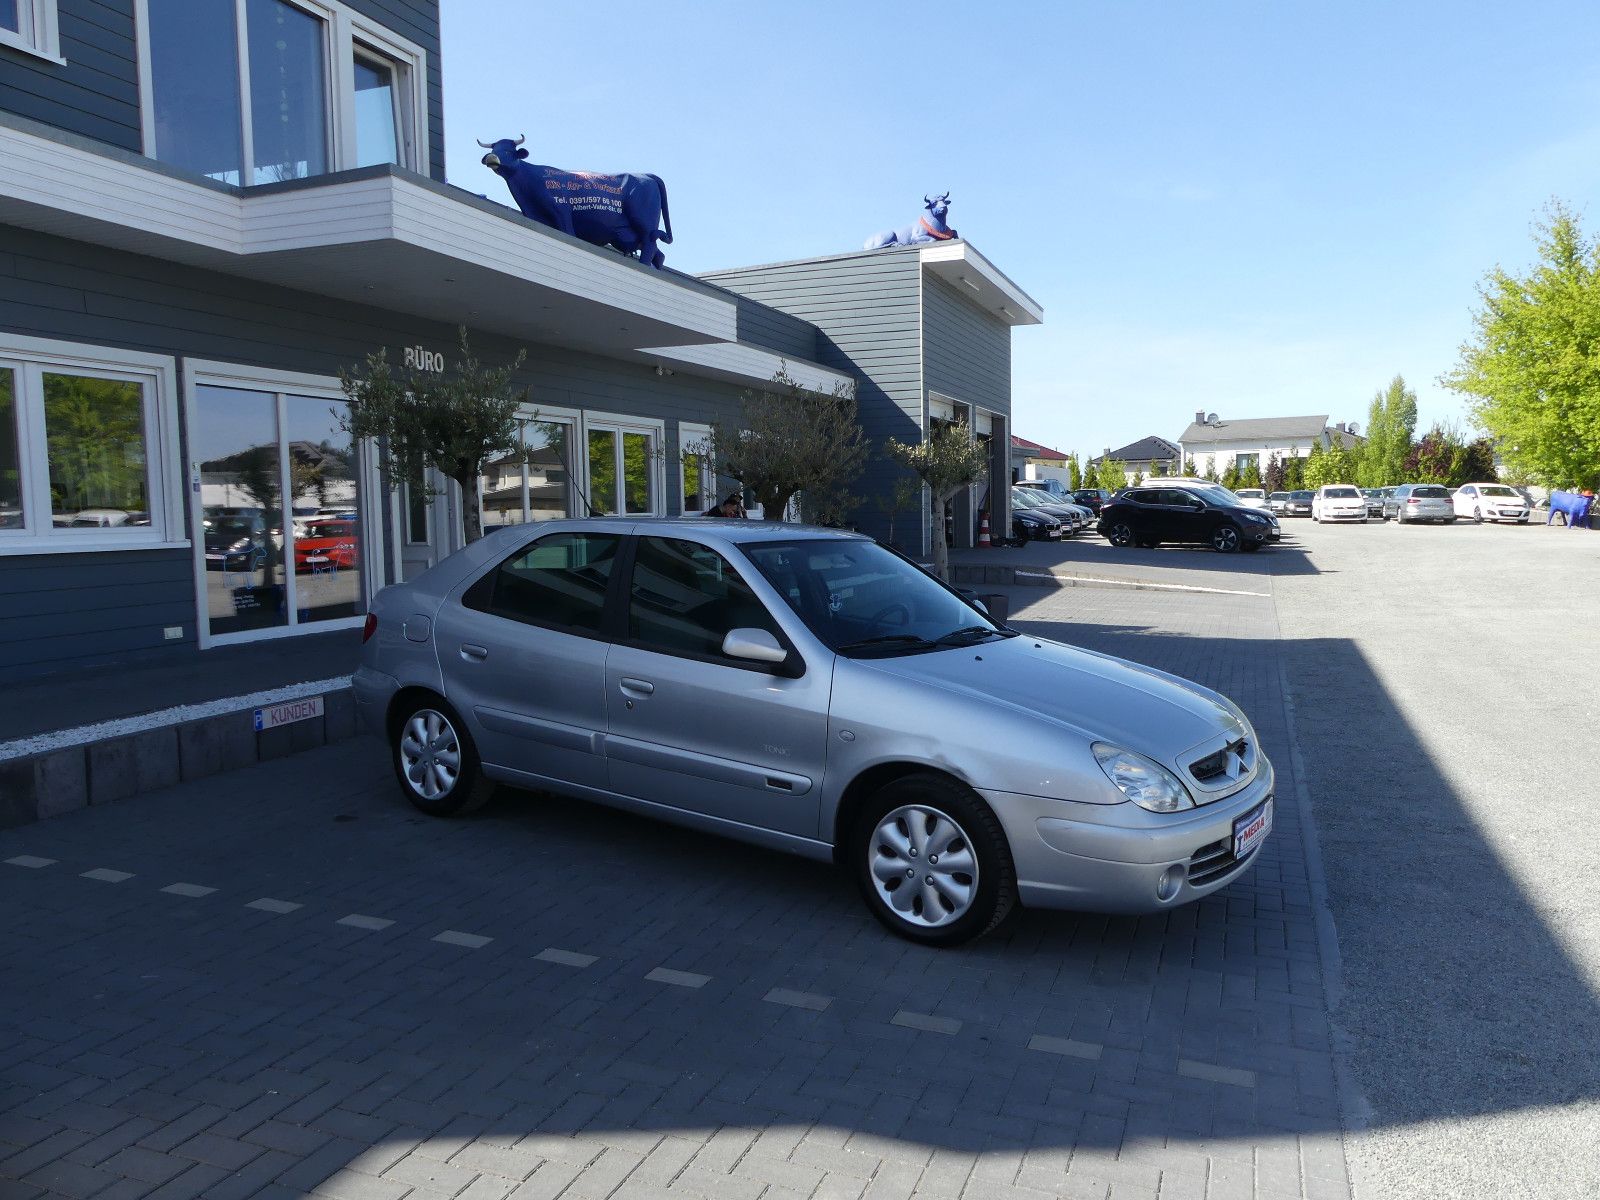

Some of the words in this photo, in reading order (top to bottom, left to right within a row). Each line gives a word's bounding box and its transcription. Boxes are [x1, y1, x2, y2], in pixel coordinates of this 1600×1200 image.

[554, 196, 568, 204] Tel.
[569, 196, 601, 205] 0391/597
[611, 199, 622, 208] 100
[403, 345, 444, 373] BÜRO
[255, 714, 262, 727] P
[270, 700, 316, 725] KUNDEN
